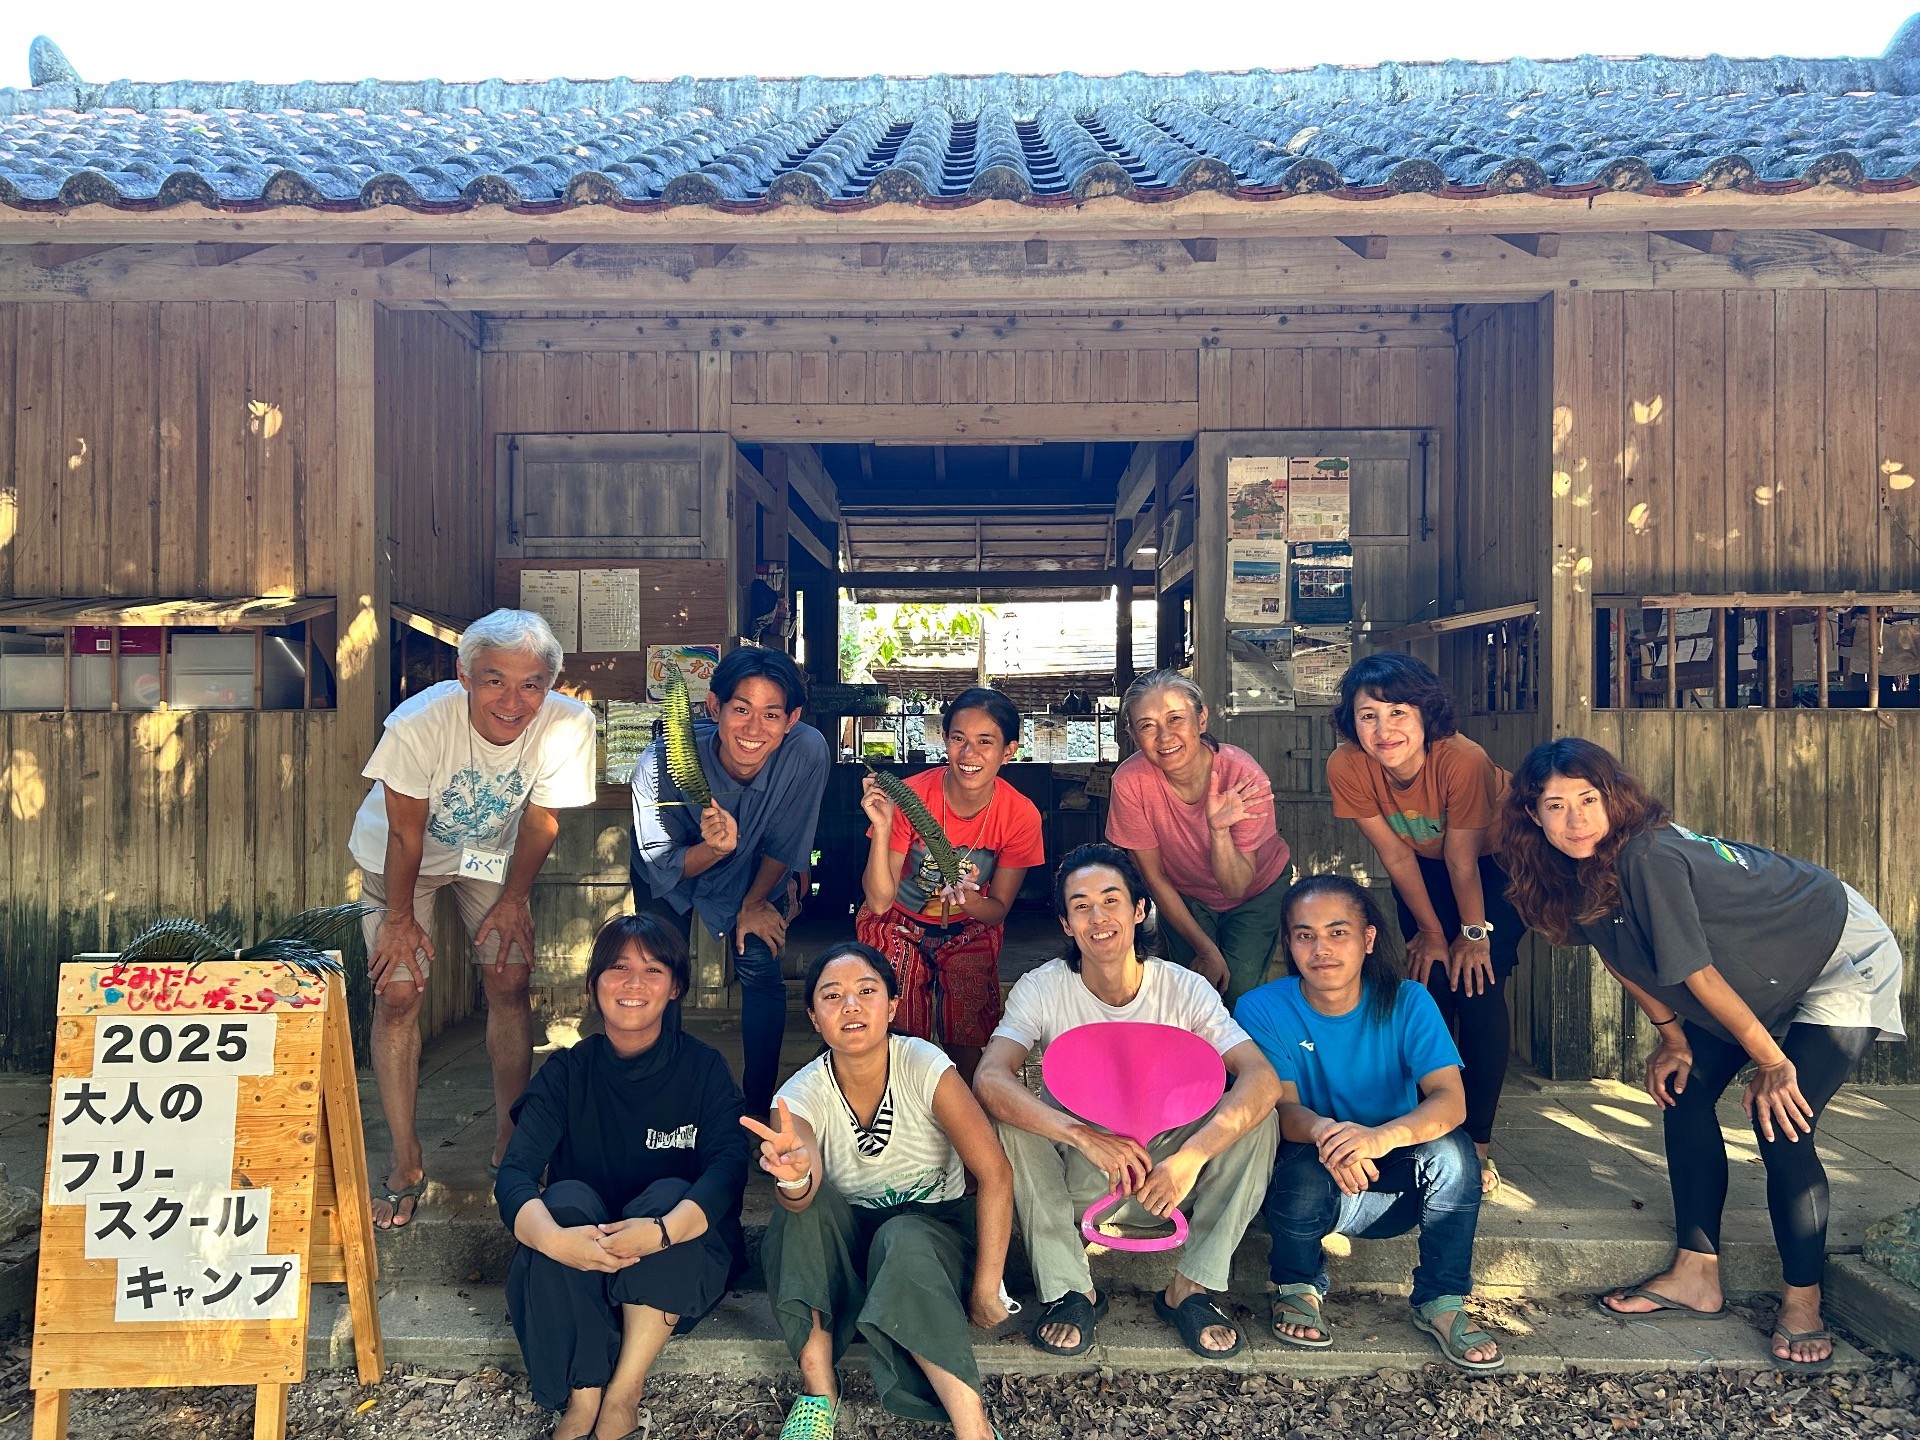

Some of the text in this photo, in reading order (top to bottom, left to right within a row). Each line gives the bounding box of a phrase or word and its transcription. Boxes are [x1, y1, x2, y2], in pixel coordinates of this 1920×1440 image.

[99, 963, 208, 989] よみたん
[101, 1023, 248, 1064] 2025
[61, 1081, 203, 1126] 大人の
[61, 1150, 174, 1193] フリー
[94, 1195, 259, 1241] スクール
[126, 1261, 293, 1310] キャンプ
